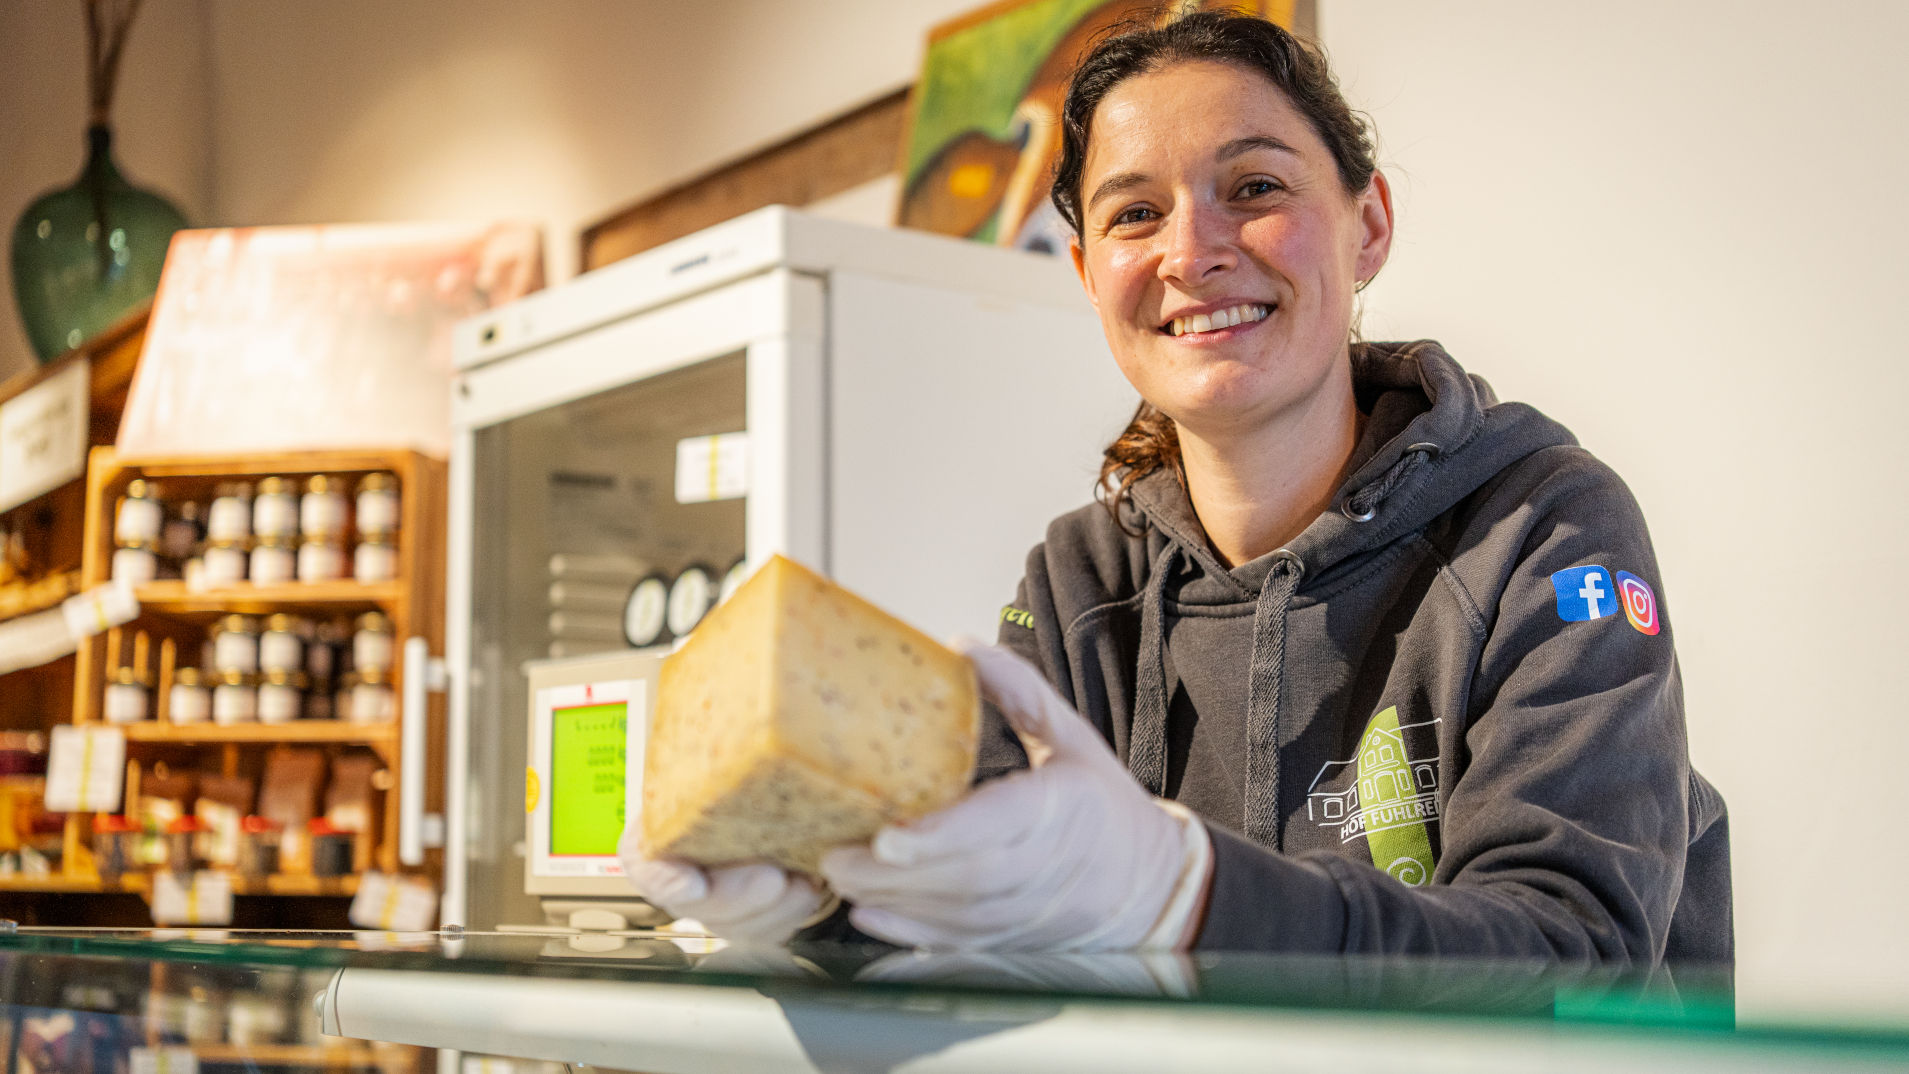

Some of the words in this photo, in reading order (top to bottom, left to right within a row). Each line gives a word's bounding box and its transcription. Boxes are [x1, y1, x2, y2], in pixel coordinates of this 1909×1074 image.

[1579, 572, 1604, 620] f
[1340, 815, 1367, 839] HOF
[1371, 800, 1439, 826] FUHLREI
